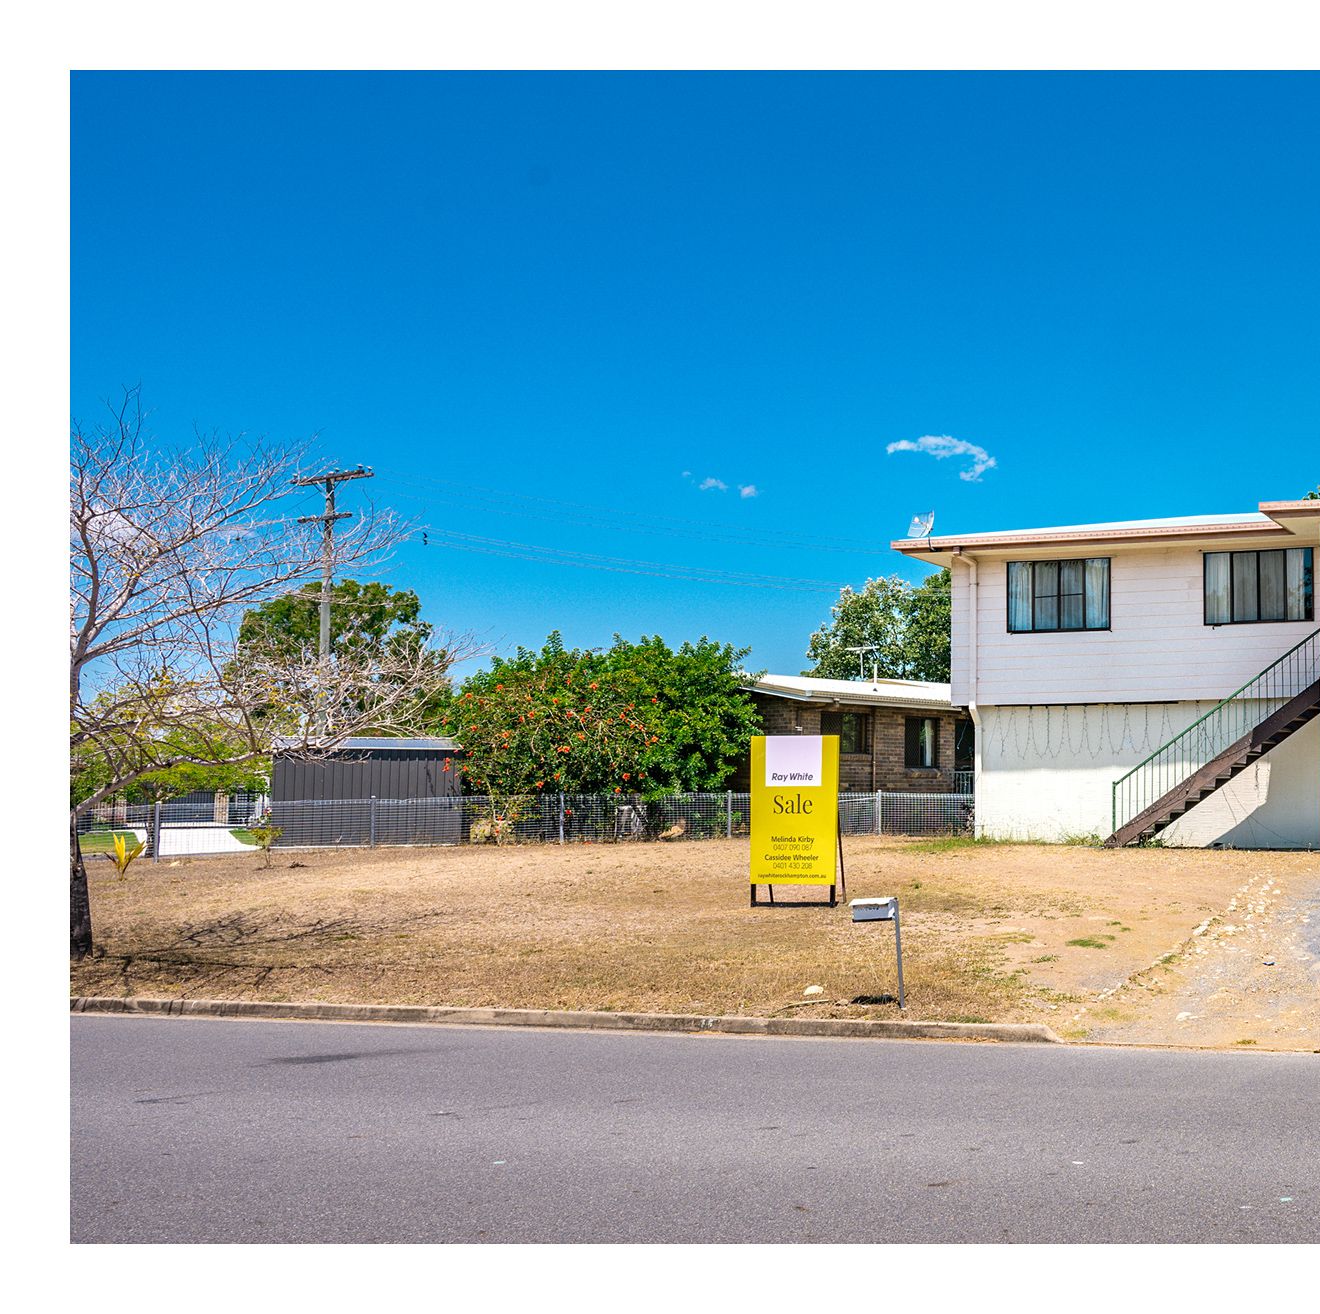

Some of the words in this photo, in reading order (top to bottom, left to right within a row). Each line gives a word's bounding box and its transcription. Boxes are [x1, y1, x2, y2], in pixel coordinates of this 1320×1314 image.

[771, 773, 788, 782] Ray
[789, 773, 813, 781] White
[773, 794, 813, 814] Sale
[771, 835, 797, 843] Melinda
[798, 835, 815, 845] Kirby
[764, 853, 792, 861] Cassidee
[793, 853, 819, 861] Wheeler
